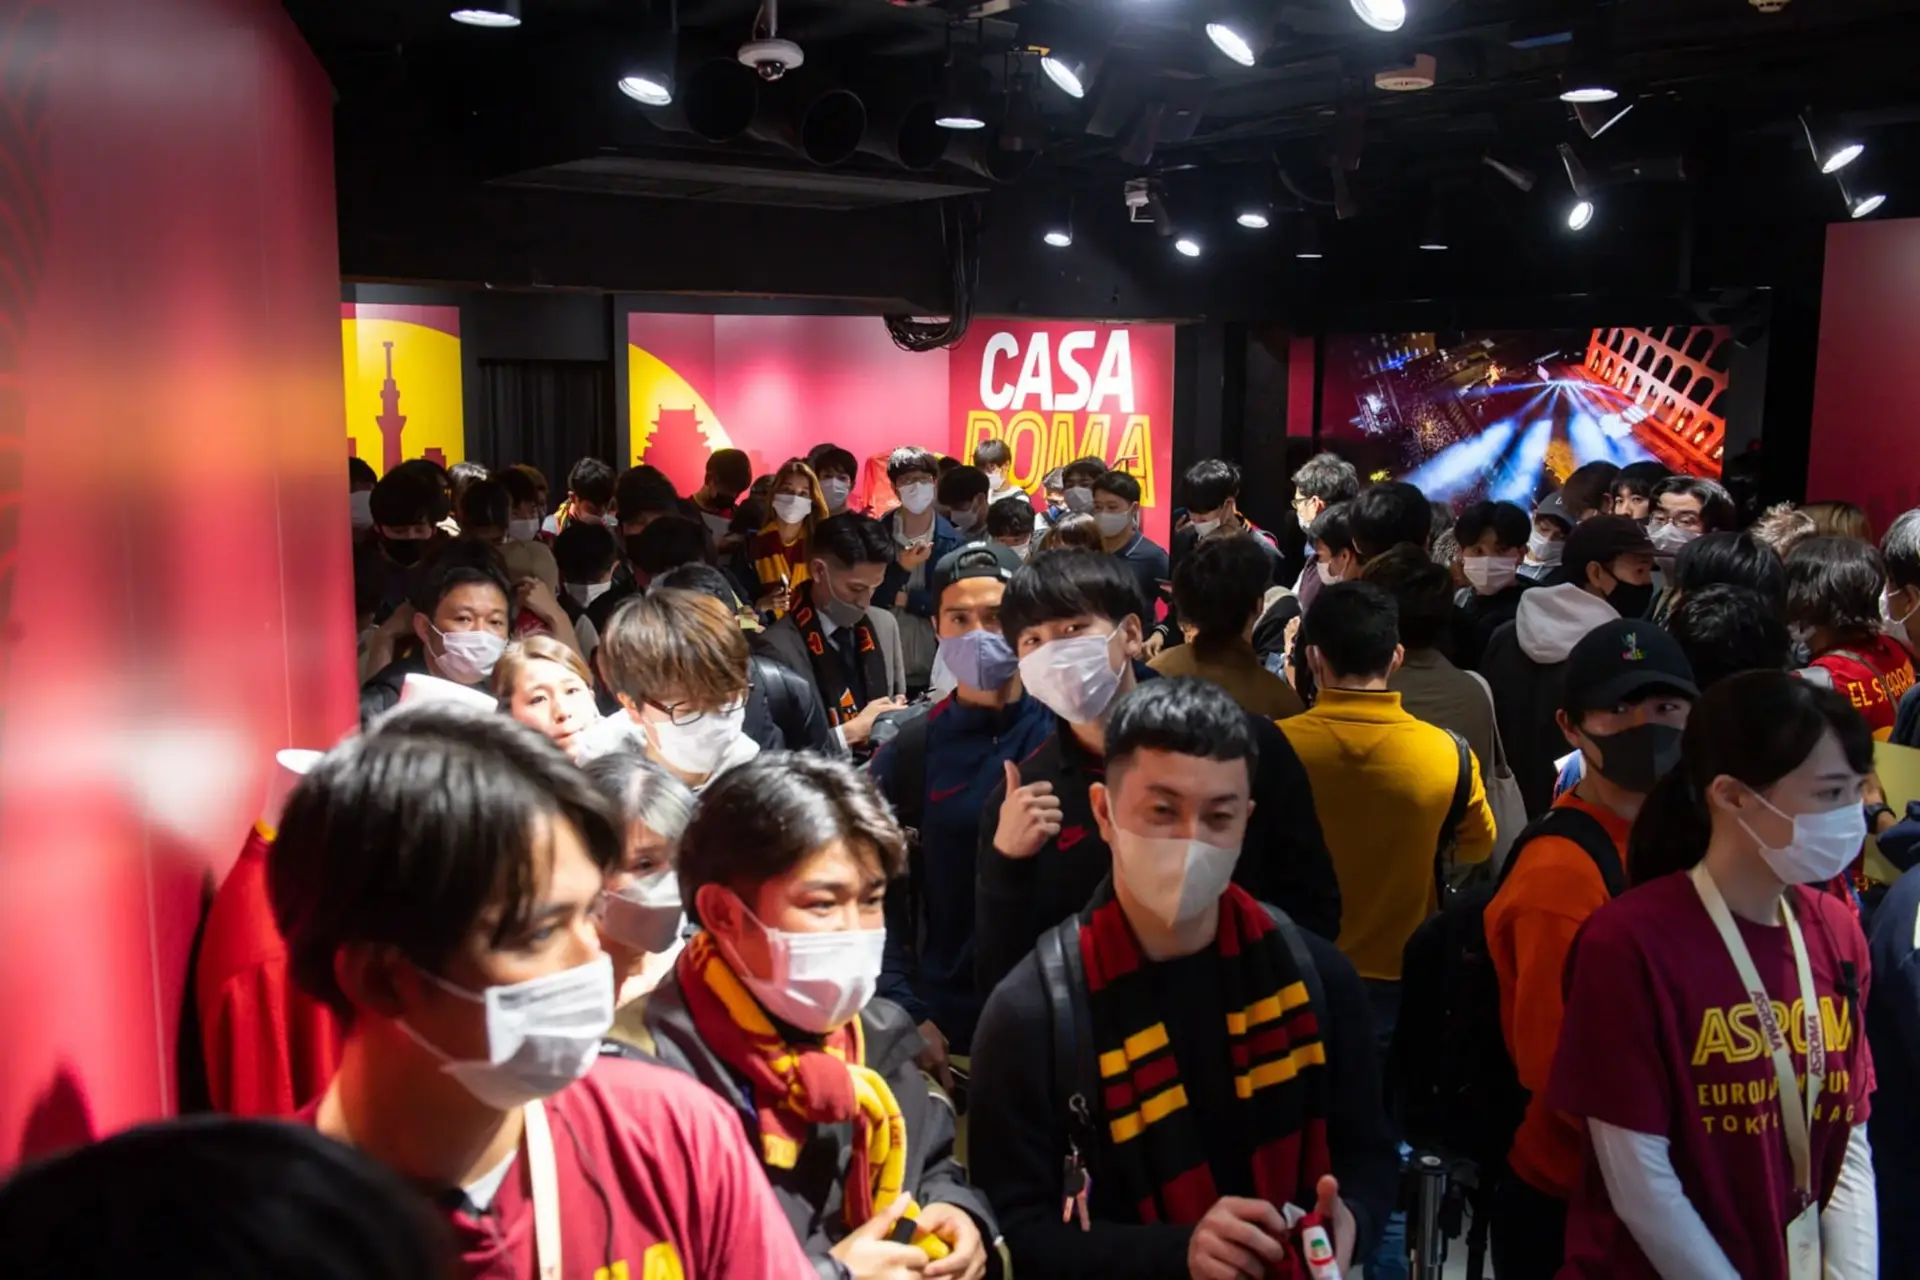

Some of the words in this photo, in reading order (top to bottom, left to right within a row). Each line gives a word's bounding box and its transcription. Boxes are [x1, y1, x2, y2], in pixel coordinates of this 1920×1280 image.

[979, 329, 1136, 413] CASA
[1847, 680, 1873, 708] EL
[1691, 996, 1852, 1065] ASROM
